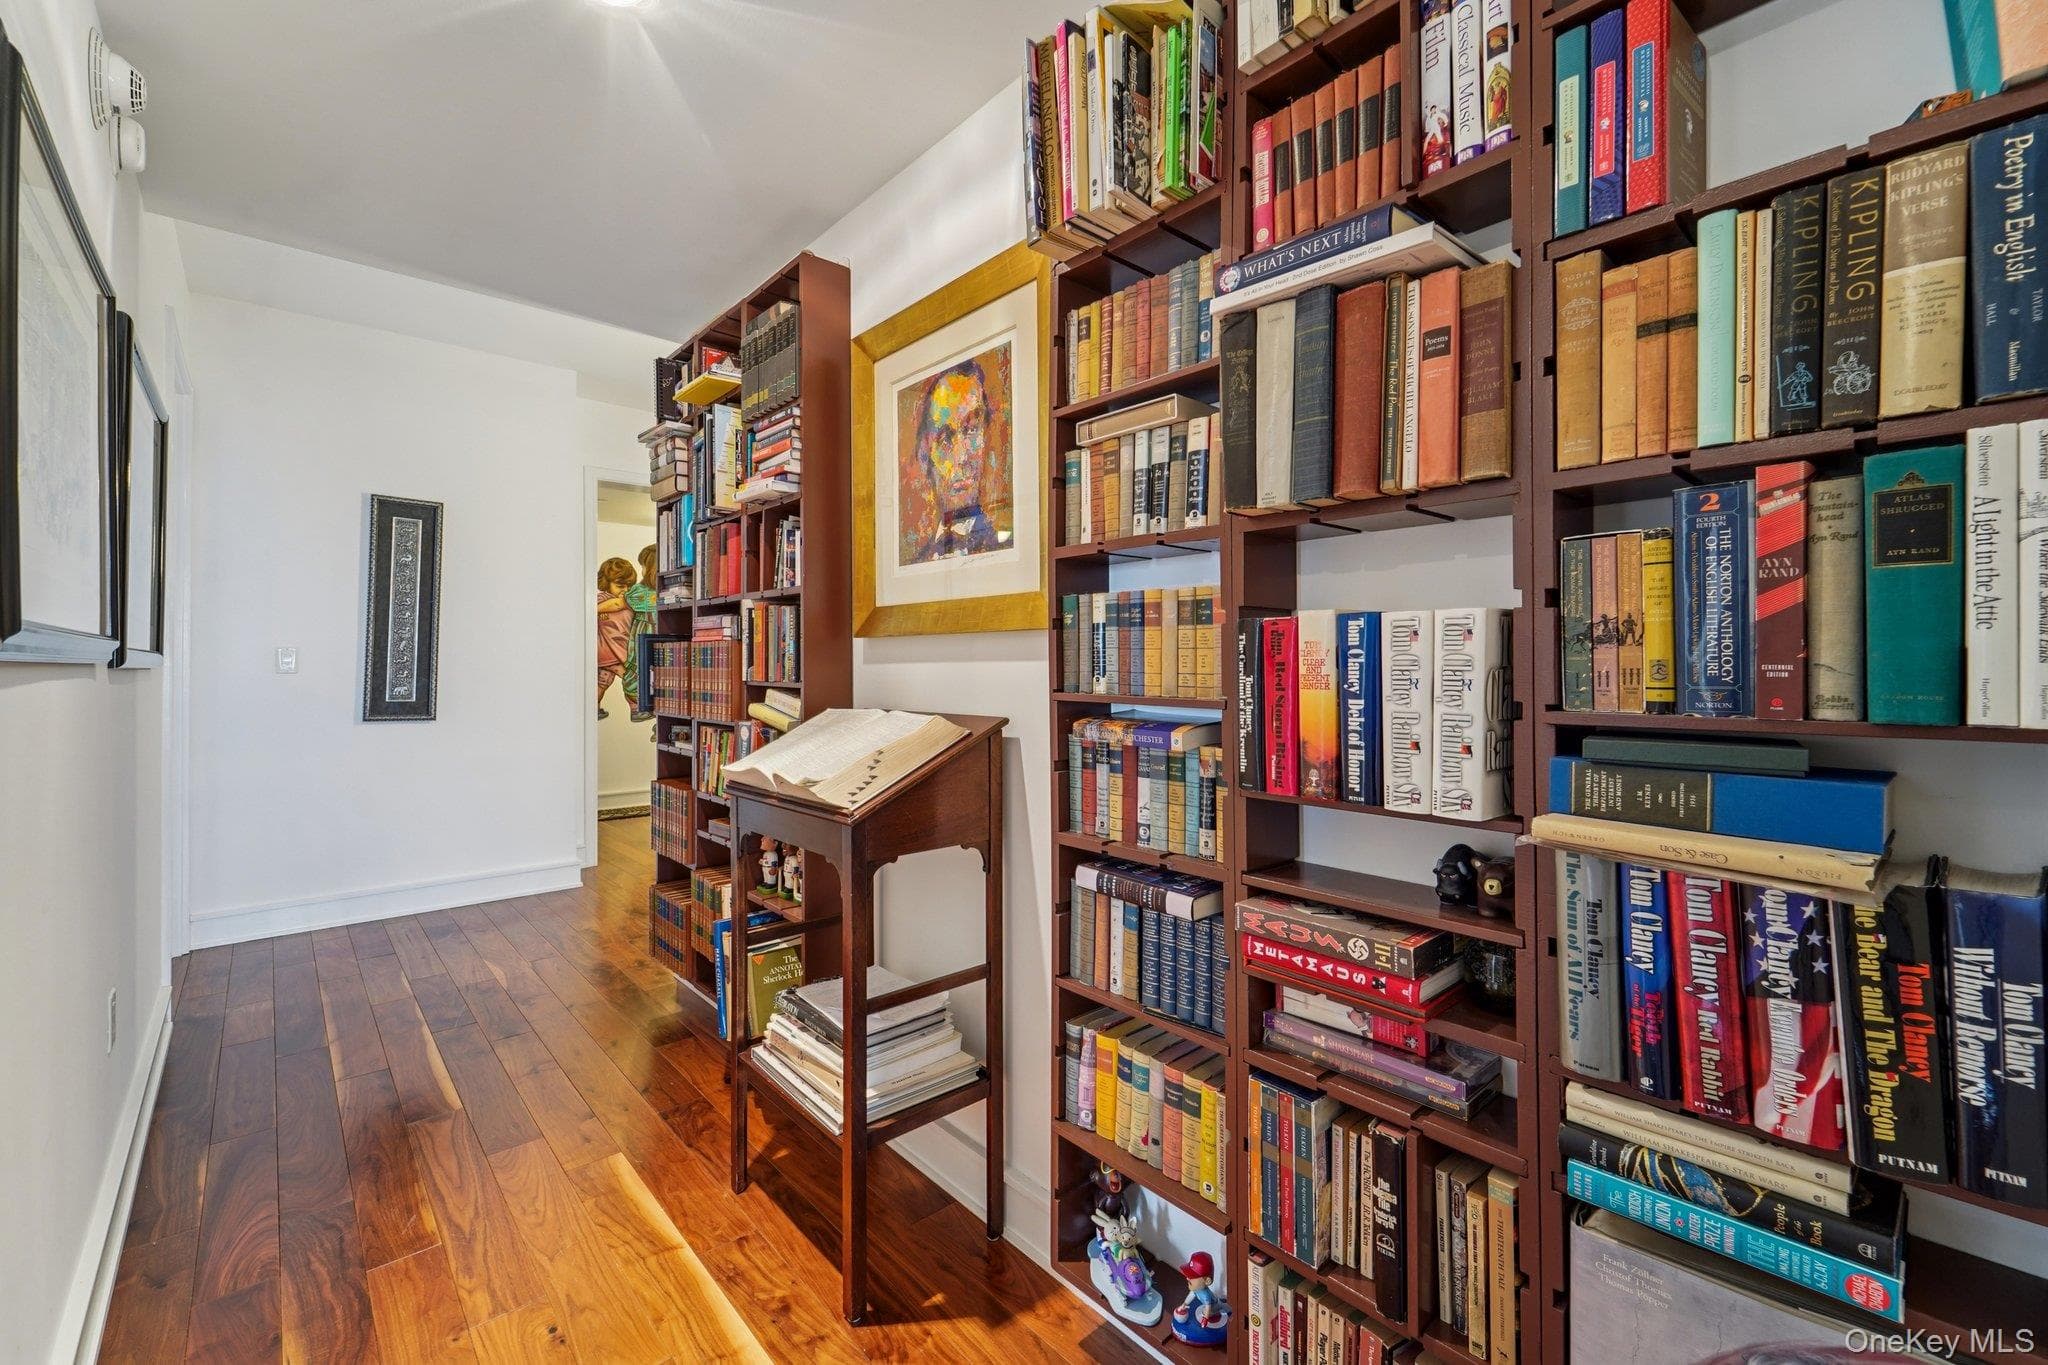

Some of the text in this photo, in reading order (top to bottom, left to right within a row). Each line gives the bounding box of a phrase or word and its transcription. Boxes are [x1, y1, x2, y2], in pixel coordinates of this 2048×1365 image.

[1425, 20, 1446, 73] Film
[1457, 4, 1475, 135] Classical Music
[1040, 42, 1054, 158] MICHELANGELO
[1890, 155, 1966, 185] RUDYARD
[1890, 172, 1965, 203] KIPLING'S
[1900, 196, 1949, 218] VERSE
[1994, 131, 2038, 283] Poetry in English
[1791, 192, 1820, 314] KIPLING
[1846, 176, 1880, 300] KIPLING
[1243, 231, 1342, 278] WHAT'S NEXT
[1562, 271, 1596, 283] OGDEN
[1986, 302, 1997, 327] HALL
[2032, 288, 2043, 323] TAYLOR
[1407, 311, 1417, 355] SONNETS
[1425, 335, 1449, 346] Poems
[2008, 340, 2021, 381] Macmillan
[1405, 372, 1416, 453] MICHELANGELO
[1976, 435, 1991, 487] Silverstein
[1699, 492, 1721, 512] 2
[1817, 491, 1843, 501] The
[1879, 502, 1945, 515] SHRUGGED
[1894, 492, 1931, 504] ATLAS
[1696, 514, 1727, 524] FOURTH
[1696, 520, 1727, 529] EDITION
[1816, 512, 1844, 523] head
[1969, 509, 2001, 547] Light
[1761, 556, 1793, 568] AYN
[1886, 547, 1940, 556] AYN RAND
[1979, 550, 2000, 562] in
[1758, 566, 1800, 579] RAND
[1979, 567, 2000, 592] the
[1705, 536, 1719, 677] OF ENGLISH LITERATURE
[1719, 527, 1734, 684] THE NORTON ANTHOLOGY
[1973, 592, 2002, 630] Attic
[1238, 632, 1246, 652] The
[1303, 641, 1321, 649] TOM
[1302, 658, 1326, 667] CLEAR
[1306, 666, 1322, 675] AND
[1761, 663, 1794, 671] CENTENNIAL
[1766, 670, 1789, 678] EDITION
[1300, 674, 1330, 682] PRESENT
[1300, 681, 1330, 690] DANGER
[1239, 699, 1246, 709] of
[1245, 675, 1253, 734] Tom Clancy
[1344, 617, 1366, 795] Tom Clancy Debt of Honor
[1386, 616, 1421, 809] Tom Clancy Rainbow Six
[1436, 616, 1475, 815] Tom Clancy Rainbow Six
[1695, 701, 1733, 710] NORTON
[1273, 660, 1286, 788] Red Storm Rising
[1659, 844, 1728, 865] Case Son
[1242, 911, 1346, 954] MAUS
[1625, 863, 1663, 975] Tom Clancy
[782, 955, 799, 964] The
[1566, 851, 1584, 1041] The Sum of All Fears
[1583, 898, 1604, 1000] Tom Clancy
[762, 971, 793, 985] Sherlock
[1252, 941, 1367, 985] METAMAUS
[1684, 876, 1727, 1101] Tom Clancy Red Rabbit
[1854, 903, 1900, 1142] he Bear and The Dragon
[1897, 961, 1936, 1084] Tom Clancy
[1953, 946, 1997, 1107] Without Remorse
[1993, 981, 2046, 1090] Tom Clancy
[1328, 1038, 1375, 1064] SHAKESPEARE
[1769, 997, 1807, 1119] Executive Orders
[1694, 1100, 1733, 1115] PUTNAM
[1878, 1153, 1939, 1175] PUTNAM
[1984, 1166, 2028, 1189] PUTNAM
[1363, 1163, 1371, 1200] HOBBIT
[1608, 1190, 1627, 1208] The
[1628, 1189, 1642, 1219] YIDDISH
[1654, 1199, 1672, 1231] UNION
[1688, 1212, 1701, 1241] PULITZER
[1773, 1202, 1789, 1235] People
[1362, 1223, 1371, 1247] Tolkien
[1703, 1217, 1721, 1249] PRIZE
[1723, 1224, 1736, 1255] WINNING
[1810, 1220, 1824, 1247] Book
[1376, 1245, 1395, 1259] VIKING
[1778, 1247, 1790, 1275] AMAZING
[1595, 1261, 1673, 1300] Christof Thoenes
[1602, 1253, 1665, 1286] Frank Zöllner
[1813, 1258, 1828, 1282] CLAY
[1600, 1274, 1670, 1309] Thomas Popper
[1850, 1274, 1867, 1304] MICHAEL
[1867, 1279, 1884, 1311] CHABON
[1280, 1305, 1291, 1350] Jailbird
[1318, 1332, 1329, 1357] Player
